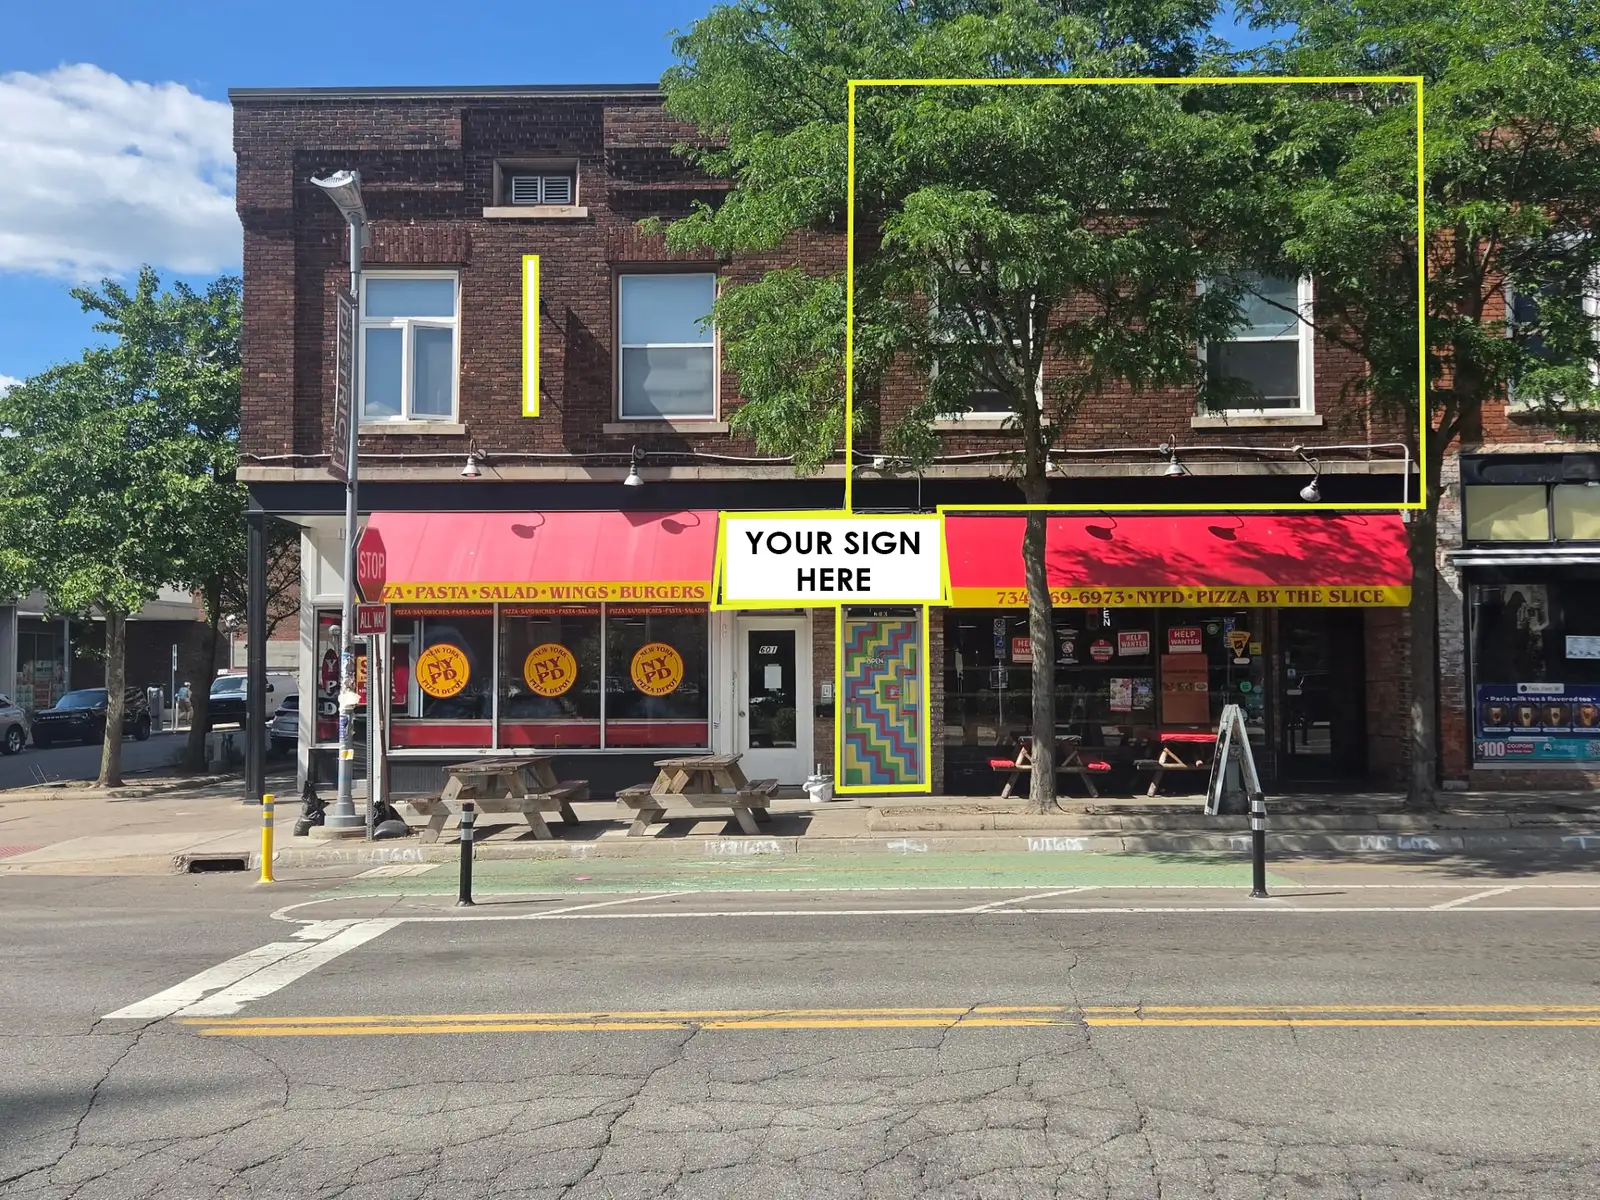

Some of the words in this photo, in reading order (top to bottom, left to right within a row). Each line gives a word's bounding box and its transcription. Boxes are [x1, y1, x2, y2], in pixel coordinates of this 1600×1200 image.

[338, 305, 349, 462] DISTRICT
[360, 551, 385, 579] STOP
[415, 586, 470, 599] PASTA
[480, 586, 539, 599] SALAD
[549, 586, 609, 599] WINGS
[619, 586, 705, 599] BURGERS
[1136, 590, 1185, 604] NYPD
[1196, 590, 1250, 603] PIZZA
[1257, 590, 1280, 603] BY
[1285, 590, 1323, 603] THE
[1328, 590, 1385, 603] SLICE
[360, 611, 372, 629] ALL
[373, 611, 385, 628] WAY
[1174, 630, 1196, 638] HELP
[760, 646, 777, 654] 601
[1121, 640, 1147, 648] WANTED
[426, 647, 440, 658] NEW
[442, 647, 459, 658] YORK
[533, 647, 547, 658] NEW
[549, 646, 567, 658] YORK
[640, 647, 654, 658] NEW
[656, 646, 674, 658] YORK
[428, 656, 454, 674] NY
[535, 656, 560, 673] NY
[641, 655, 667, 673] NY
[430, 668, 458, 685] PD
[538, 668, 565, 684] PD
[644, 667, 672, 684] PD
[422, 679, 440, 694] PIZZA
[441, 679, 464, 694] DEPOT
[530, 679, 547, 693] PIZZA
[549, 679, 570, 693] DEPOT
[637, 678, 654, 692] PIZZA
[656, 678, 678, 692] DEPOT
